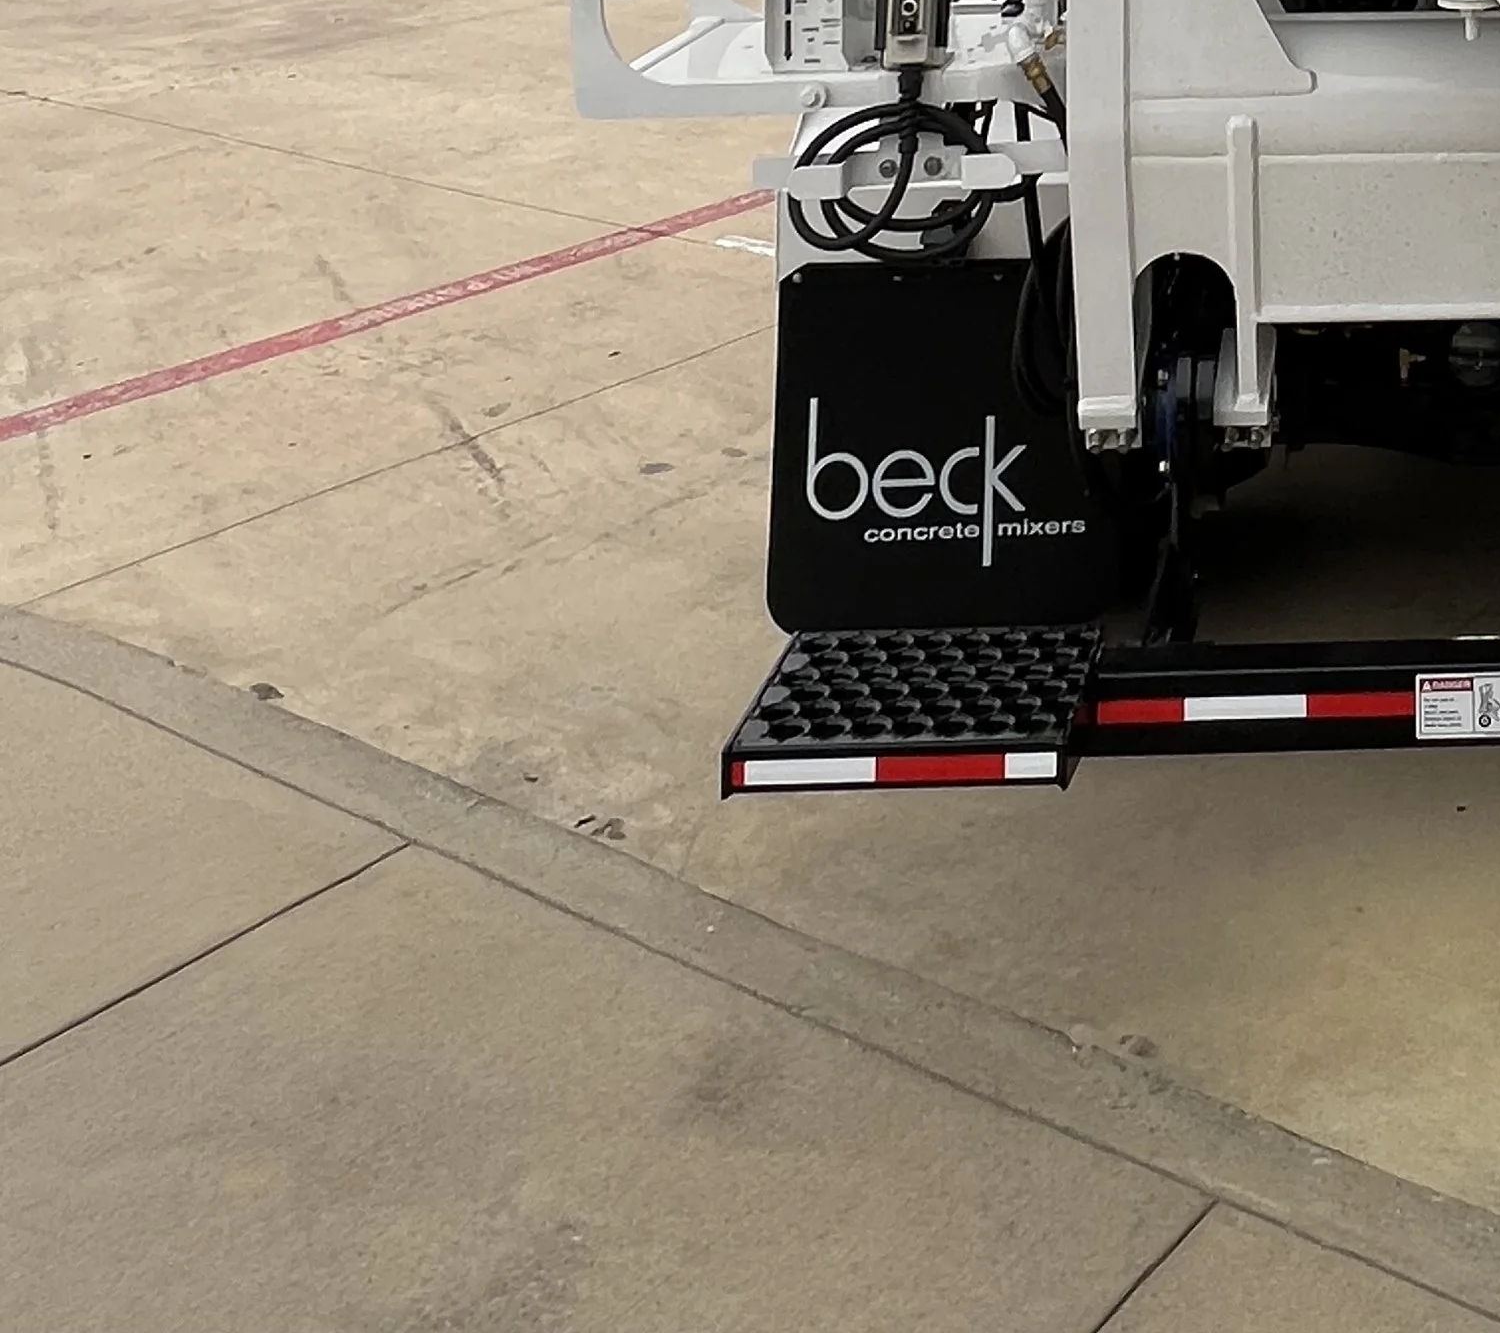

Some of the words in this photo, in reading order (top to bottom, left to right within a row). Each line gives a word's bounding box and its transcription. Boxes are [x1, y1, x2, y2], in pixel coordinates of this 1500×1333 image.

[806, 397, 1027, 567] beck
[864, 521, 980, 543] concrete
[997, 518, 1086, 537] mixers
